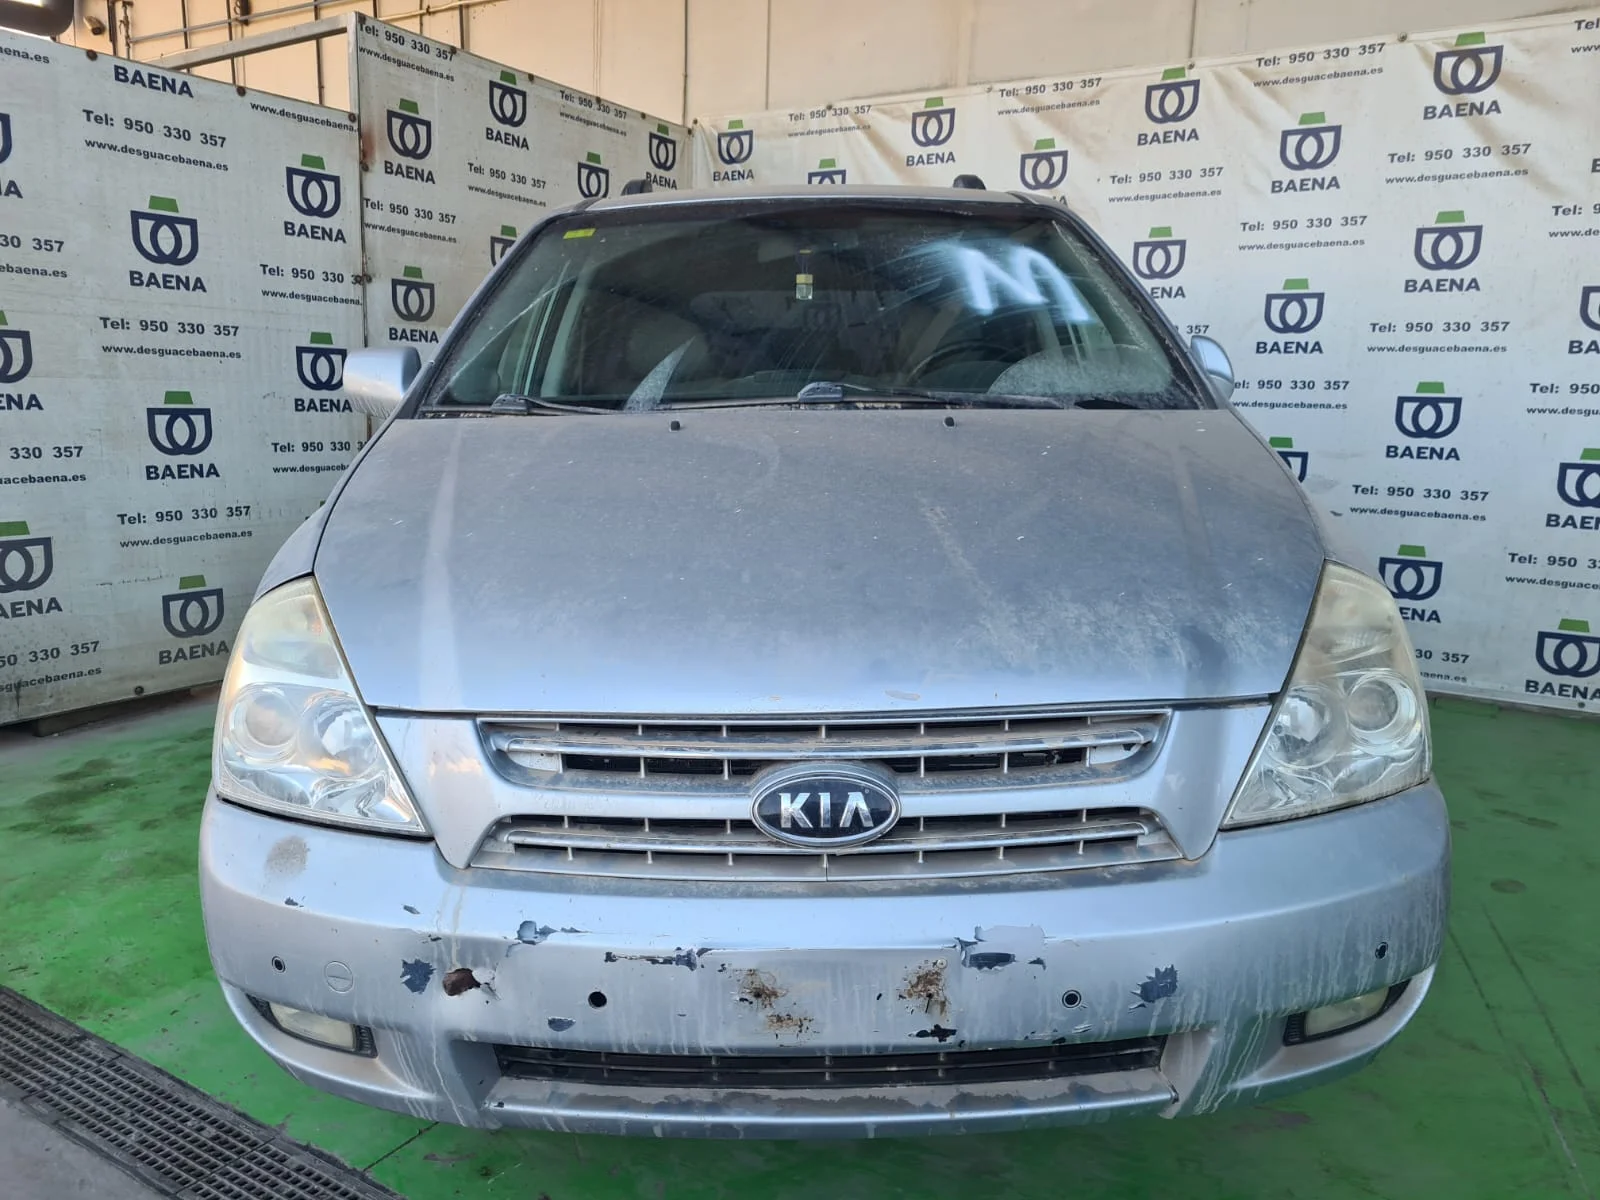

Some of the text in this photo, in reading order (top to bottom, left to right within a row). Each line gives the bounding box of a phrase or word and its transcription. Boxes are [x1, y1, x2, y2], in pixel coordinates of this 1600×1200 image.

[359, 23, 454, 62] Tel: 950 330 357
[1256, 42, 1386, 67] Tel: 950 330 357
[359, 46, 455, 82] www.desguacebaena.es
[113, 64, 194, 98] BAENA
[1253, 66, 1383, 88] www.desguacebaena.es
[999, 77, 1102, 97] Tel: 950 330 357
[560, 90, 575, 103] Tel:
[578, 96, 593, 108] 950
[614, 108, 627, 119] 357
[788, 105, 872, 121] Tel: 950 330 357
[997, 99, 1100, 116] www.desguacebaena.es
[1423, 100, 1501, 120] BAENA
[250, 102, 358, 132] www.desguacebaena.
[82, 109, 226, 147] Tel: 950 330 357
[486, 127, 529, 150] BAENA
[1137, 128, 1199, 146] BAENA
[85, 138, 229, 172] www.desguacebaena.es
[906, 152, 955, 166] BAENA
[1388, 143, 1531, 163] Tel: 950 330 357
[384, 160, 435, 184] BAENA
[468, 162, 546, 189] Tel: 950 330 357
[713, 169, 754, 181] BAENA
[1110, 167, 1224, 184] Tel: 950 330 357
[1385, 169, 1528, 184] www.desguacebaena.es
[1271, 176, 1340, 193] BAENA
[468, 185, 546, 207] www.desguacebaena.es
[1109, 190, 1221, 202] www.desguacebaena.es
[364, 198, 456, 224] Tel: 950 330 357
[1552, 205, 1582, 216] Tel:
[284, 221, 346, 243] BAENA
[1240, 216, 1367, 231] Tel: 950 330 357
[364, 222, 457, 243] www.desguacebaena.es
[32, 238, 64, 252] 357
[1239, 240, 1365, 250] www.desguacebaena.es
[129, 270, 207, 293] BAENA
[260, 264, 284, 276] Tel:
[292, 268, 314, 280] 950
[322, 271, 344, 283] 330
[1404, 278, 1480, 292] BAENA
[99, 317, 239, 336] Tel: 950 330 357
[389, 327, 439, 343] BAENA
[1187, 325, 1209, 334] 357
[1370, 321, 1510, 332] Tel: 950 330 357
[102, 345, 241, 358] www.desguacebaena.es
[1256, 341, 1323, 354] BAENA
[1367, 345, 1507, 354] www.desguacebaena.es
[1234, 380, 1349, 390] el: 950 330 357
[1530, 383, 1600, 394] Tel: 950
[294, 398, 352, 412] BAENA
[10, 446, 83, 459] 330 357
[271, 442, 294, 452] Tel:
[302, 442, 323, 452] 950
[330, 441, 350, 451] 330
[1386, 445, 1460, 461] BAENA
[146, 463, 220, 480] BAENA
[1352, 485, 1489, 501] Tel: 950 330 357
[117, 506, 250, 525] Tel: 950 330 357
[1350, 507, 1486, 521] www.desguacebaena.es
[120, 531, 252, 548] www.desguacebaena.es
[1508, 553, 1537, 564] Tel:
[1548, 556, 1577, 567] 950
[29, 648, 60, 662] 330
[71, 641, 99, 655] 357
[159, 640, 230, 665] BAENA
[1442, 652, 1469, 663] 357
[779, 791, 874, 828] KIA
